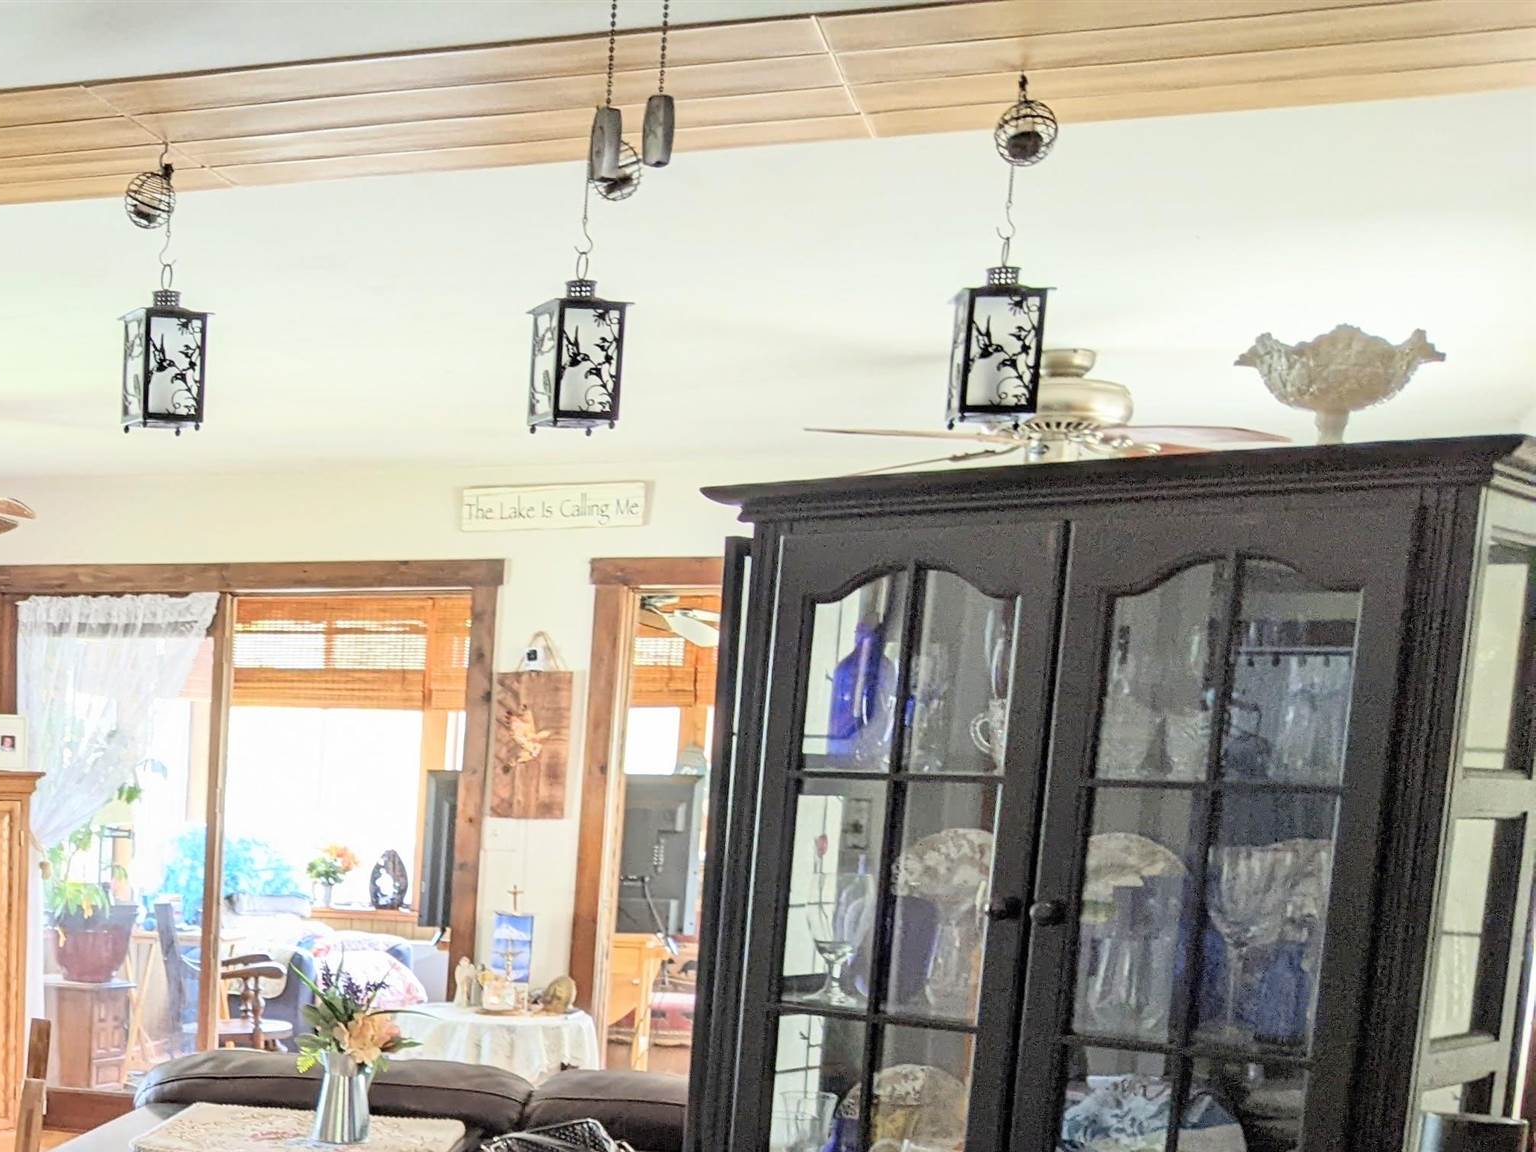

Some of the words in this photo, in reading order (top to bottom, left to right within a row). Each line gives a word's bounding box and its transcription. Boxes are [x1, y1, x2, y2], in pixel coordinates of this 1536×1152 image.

[464, 496, 493, 520] The
[499, 495, 535, 520] Lake
[541, 501, 553, 519] Is
[559, 492, 611, 526] Calling
[615, 498, 640, 516] Me
